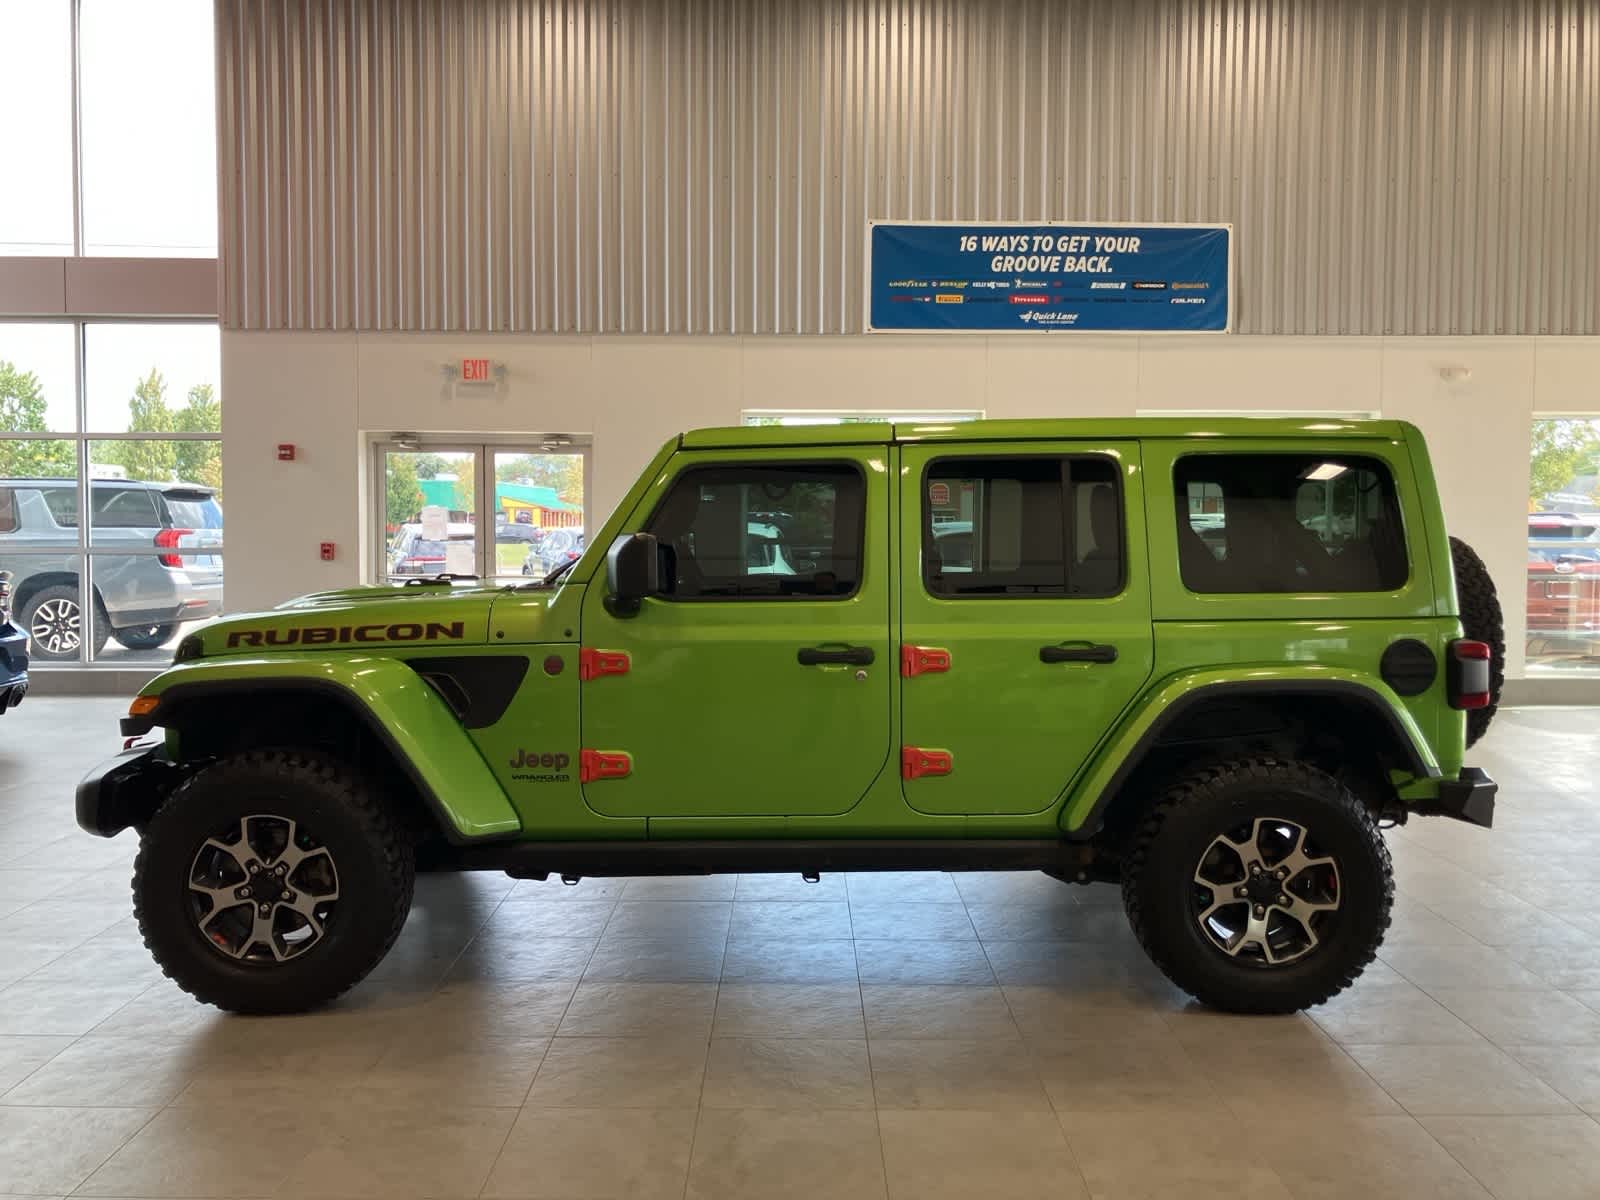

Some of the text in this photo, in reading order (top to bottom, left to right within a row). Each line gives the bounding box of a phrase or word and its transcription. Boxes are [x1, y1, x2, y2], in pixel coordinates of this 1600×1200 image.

[959, 236, 1141, 253] 16 WAYS TO GET YOUR
[991, 256, 1113, 273] GROOVE BACK.
[1032, 311, 1079, 321] Quick Lane
[463, 359, 489, 381] EXIT
[226, 621, 465, 648] RUBICON
[509, 748, 570, 772] Jeep
